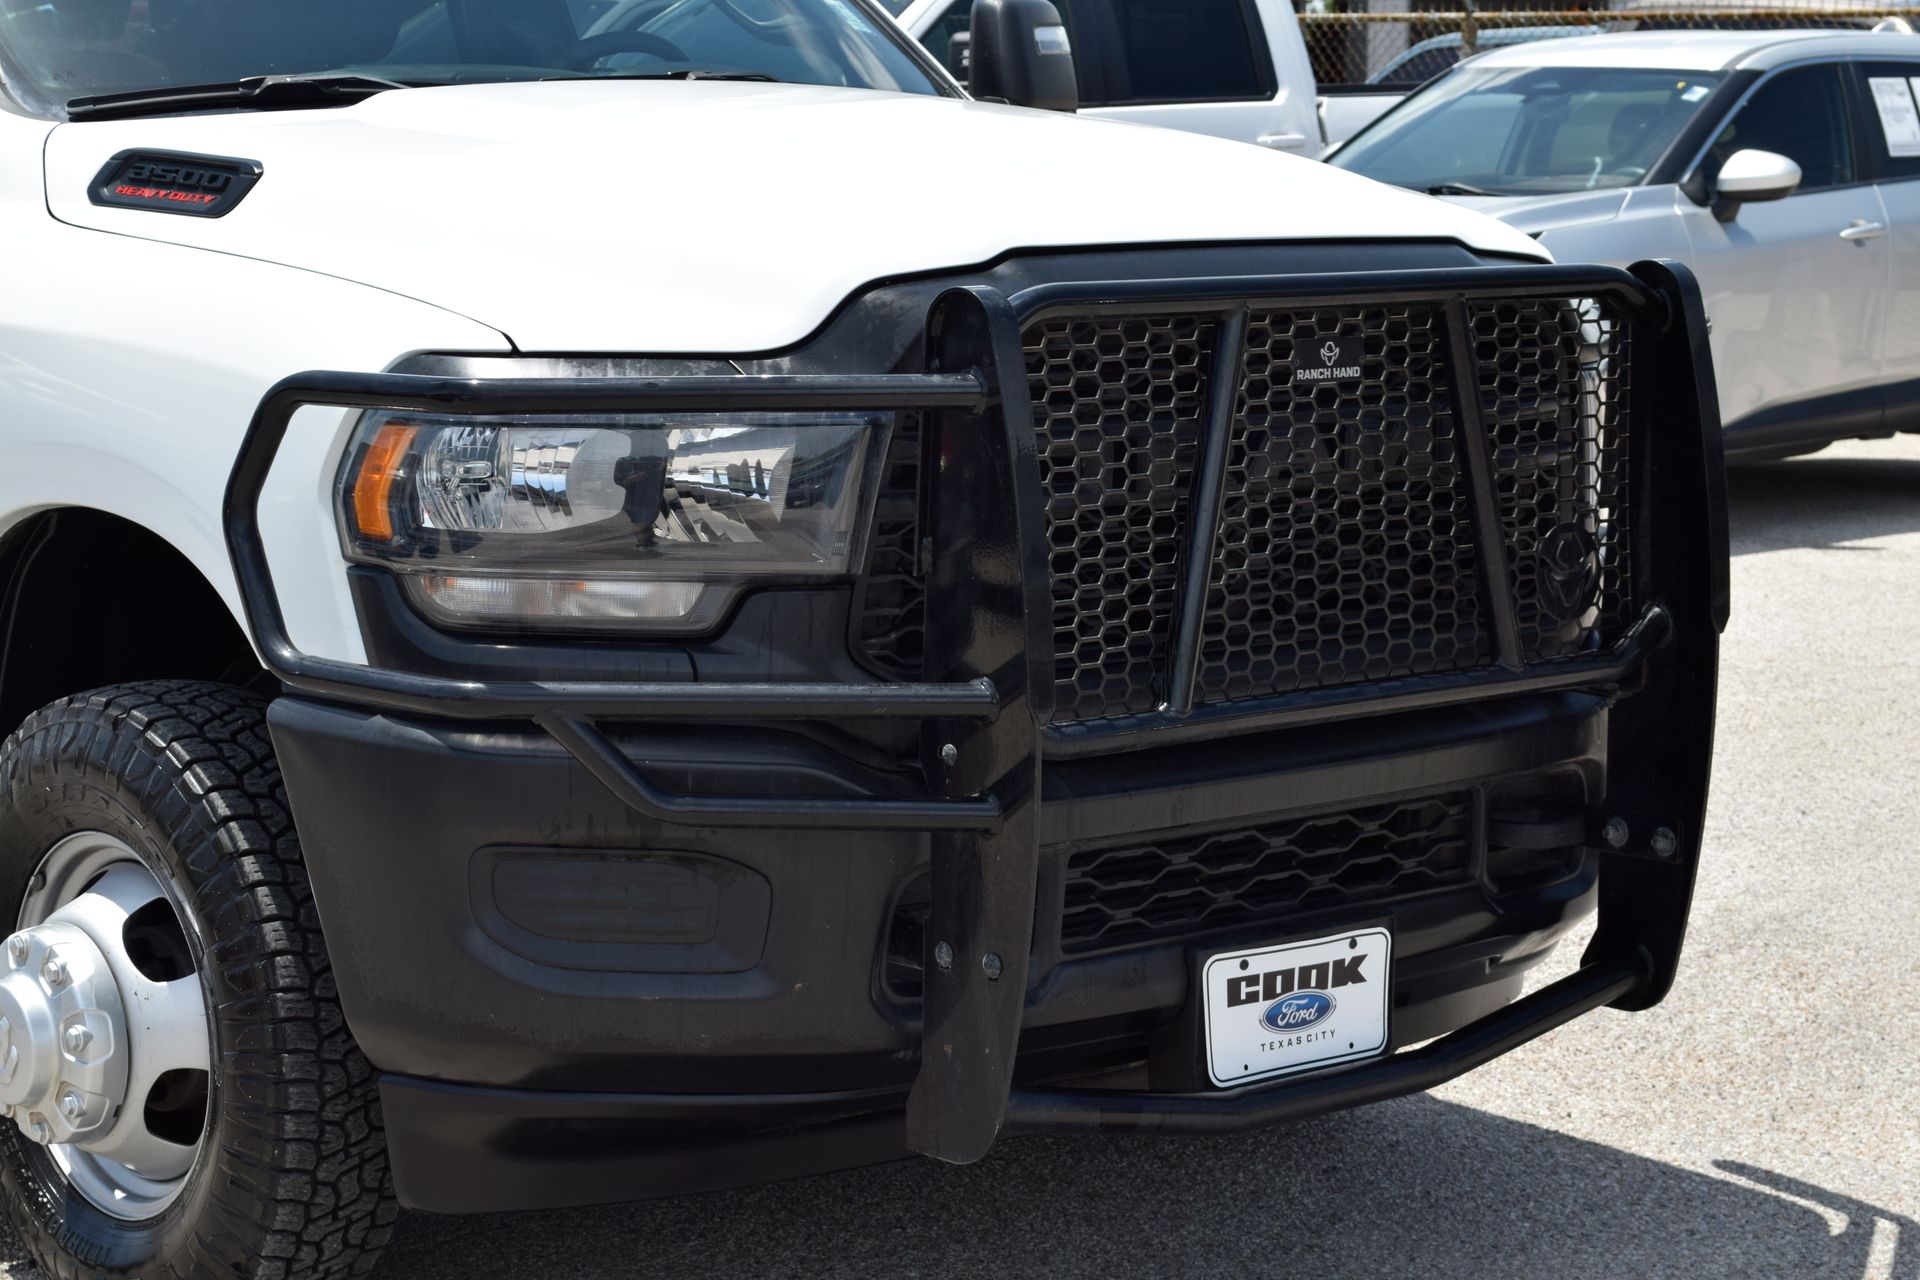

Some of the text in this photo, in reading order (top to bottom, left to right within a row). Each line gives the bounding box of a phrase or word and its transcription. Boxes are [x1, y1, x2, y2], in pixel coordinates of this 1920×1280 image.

[128, 163, 228, 188] 3500
[1296, 366, 1361, 380] RANCH HAND
[1226, 953, 1369, 1008] COOK
[1277, 998, 1318, 1026] Ford
[1260, 1029, 1336, 1052] TEXAS CITY
